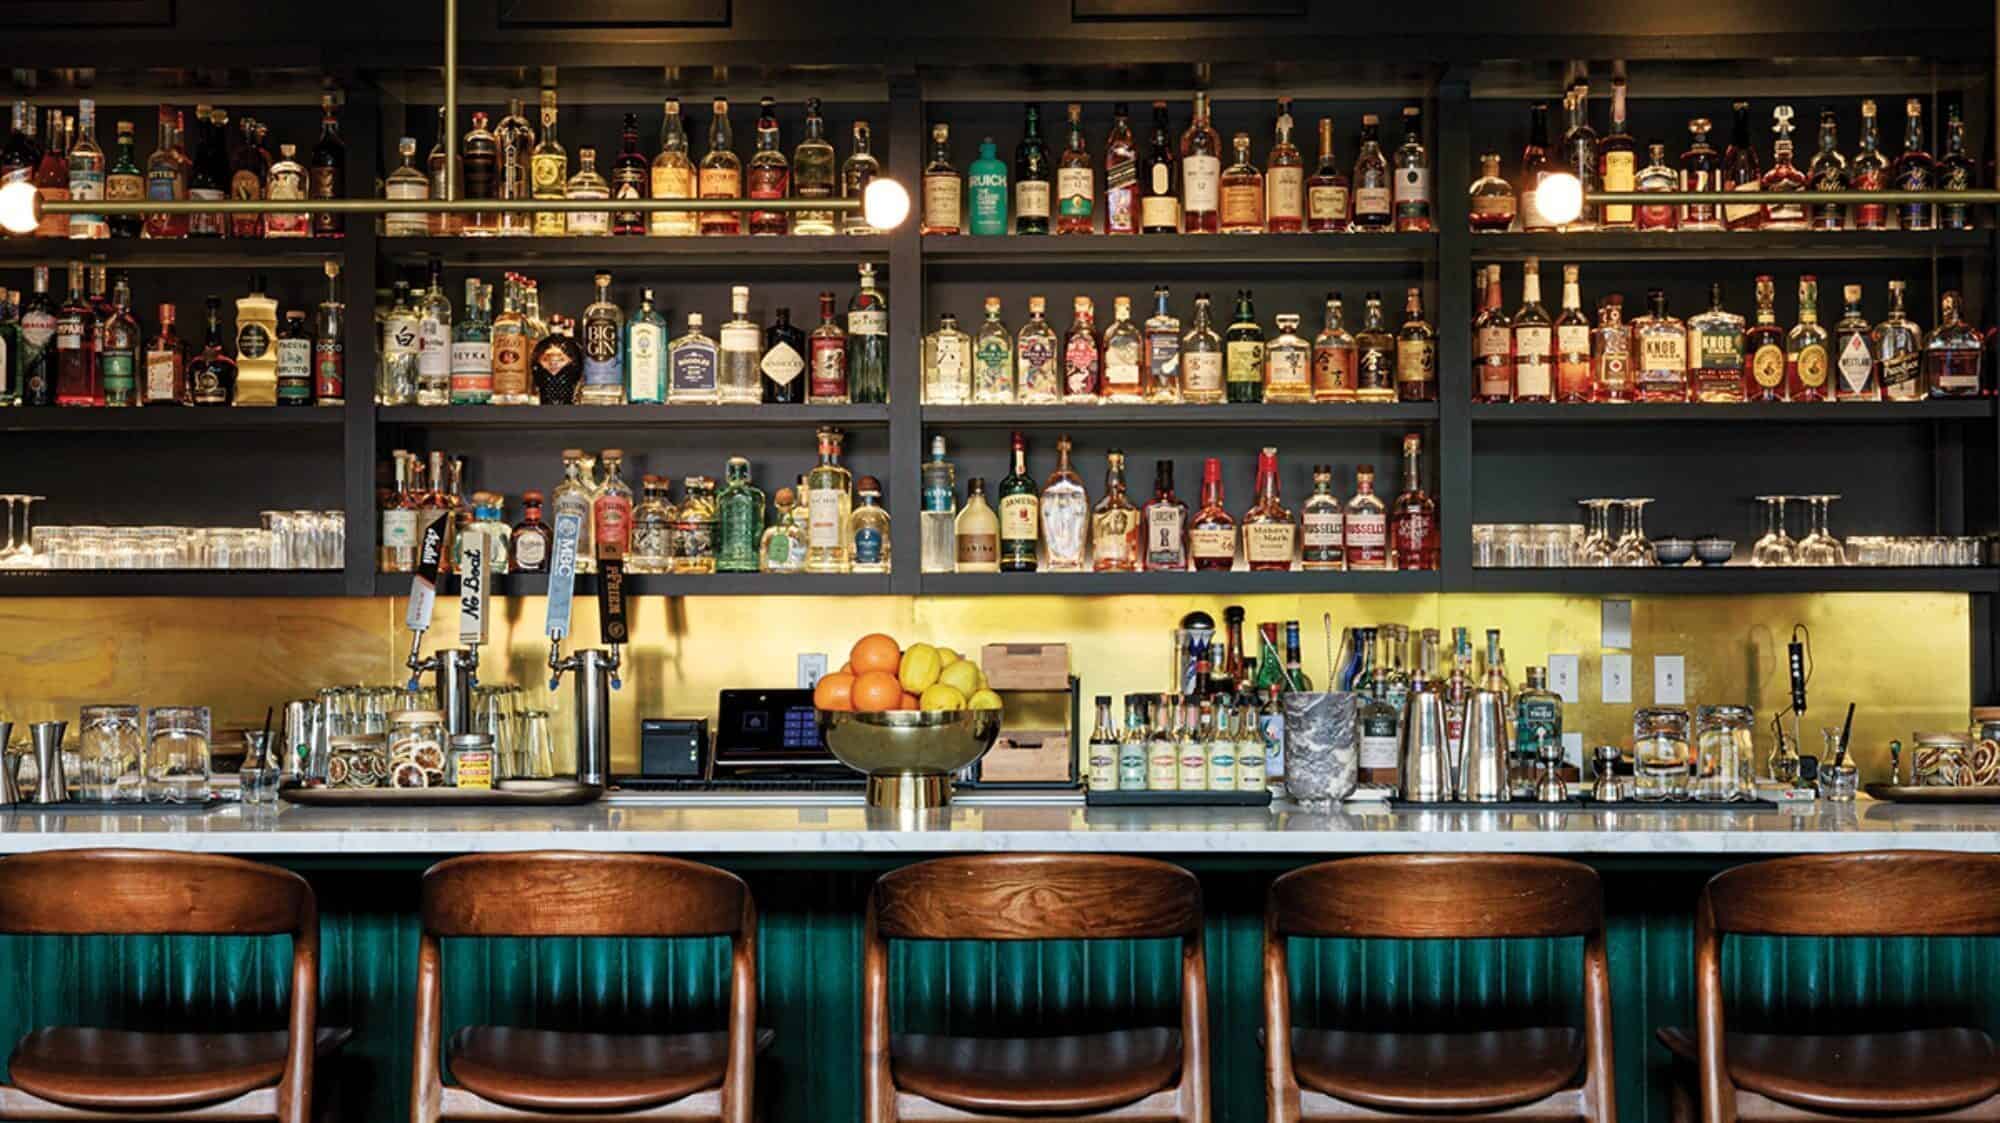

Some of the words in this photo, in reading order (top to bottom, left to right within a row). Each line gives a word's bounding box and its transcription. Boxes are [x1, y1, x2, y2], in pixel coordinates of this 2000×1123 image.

[587, 326, 615, 341] BIG
[587, 341, 615, 356] GIN
[1647, 341, 1677, 354] KNOB
[1703, 336, 1731, 350] KNOB
[422, 528, 440, 565] Asahi
[559, 541, 574, 577] MBC
[463, 550, 480, 593] Boat
[462, 598, 479, 620] No
